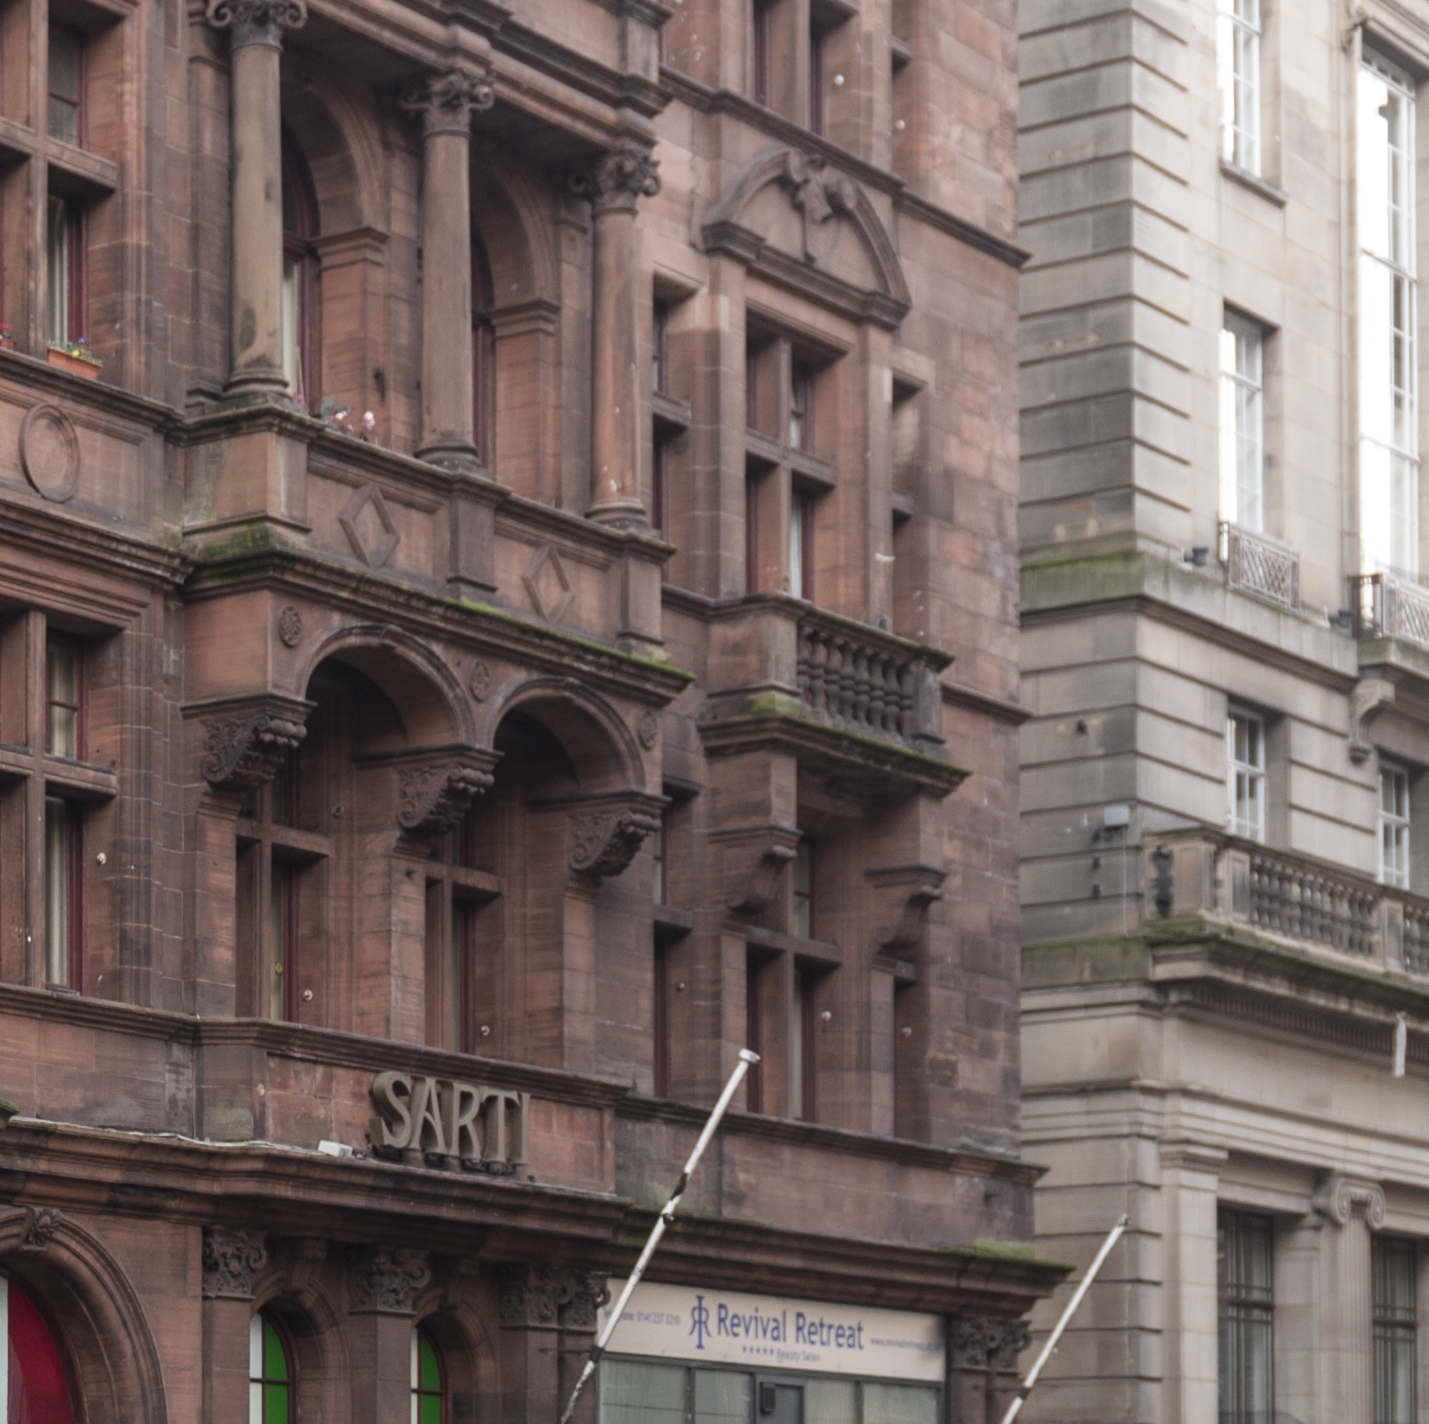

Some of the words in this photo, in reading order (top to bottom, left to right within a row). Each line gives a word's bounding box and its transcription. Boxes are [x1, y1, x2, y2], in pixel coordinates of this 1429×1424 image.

[369, 1070, 531, 1166] SARTI
[717, 1302, 788, 1343] Revival
[795, 1311, 865, 1351] Retreat
